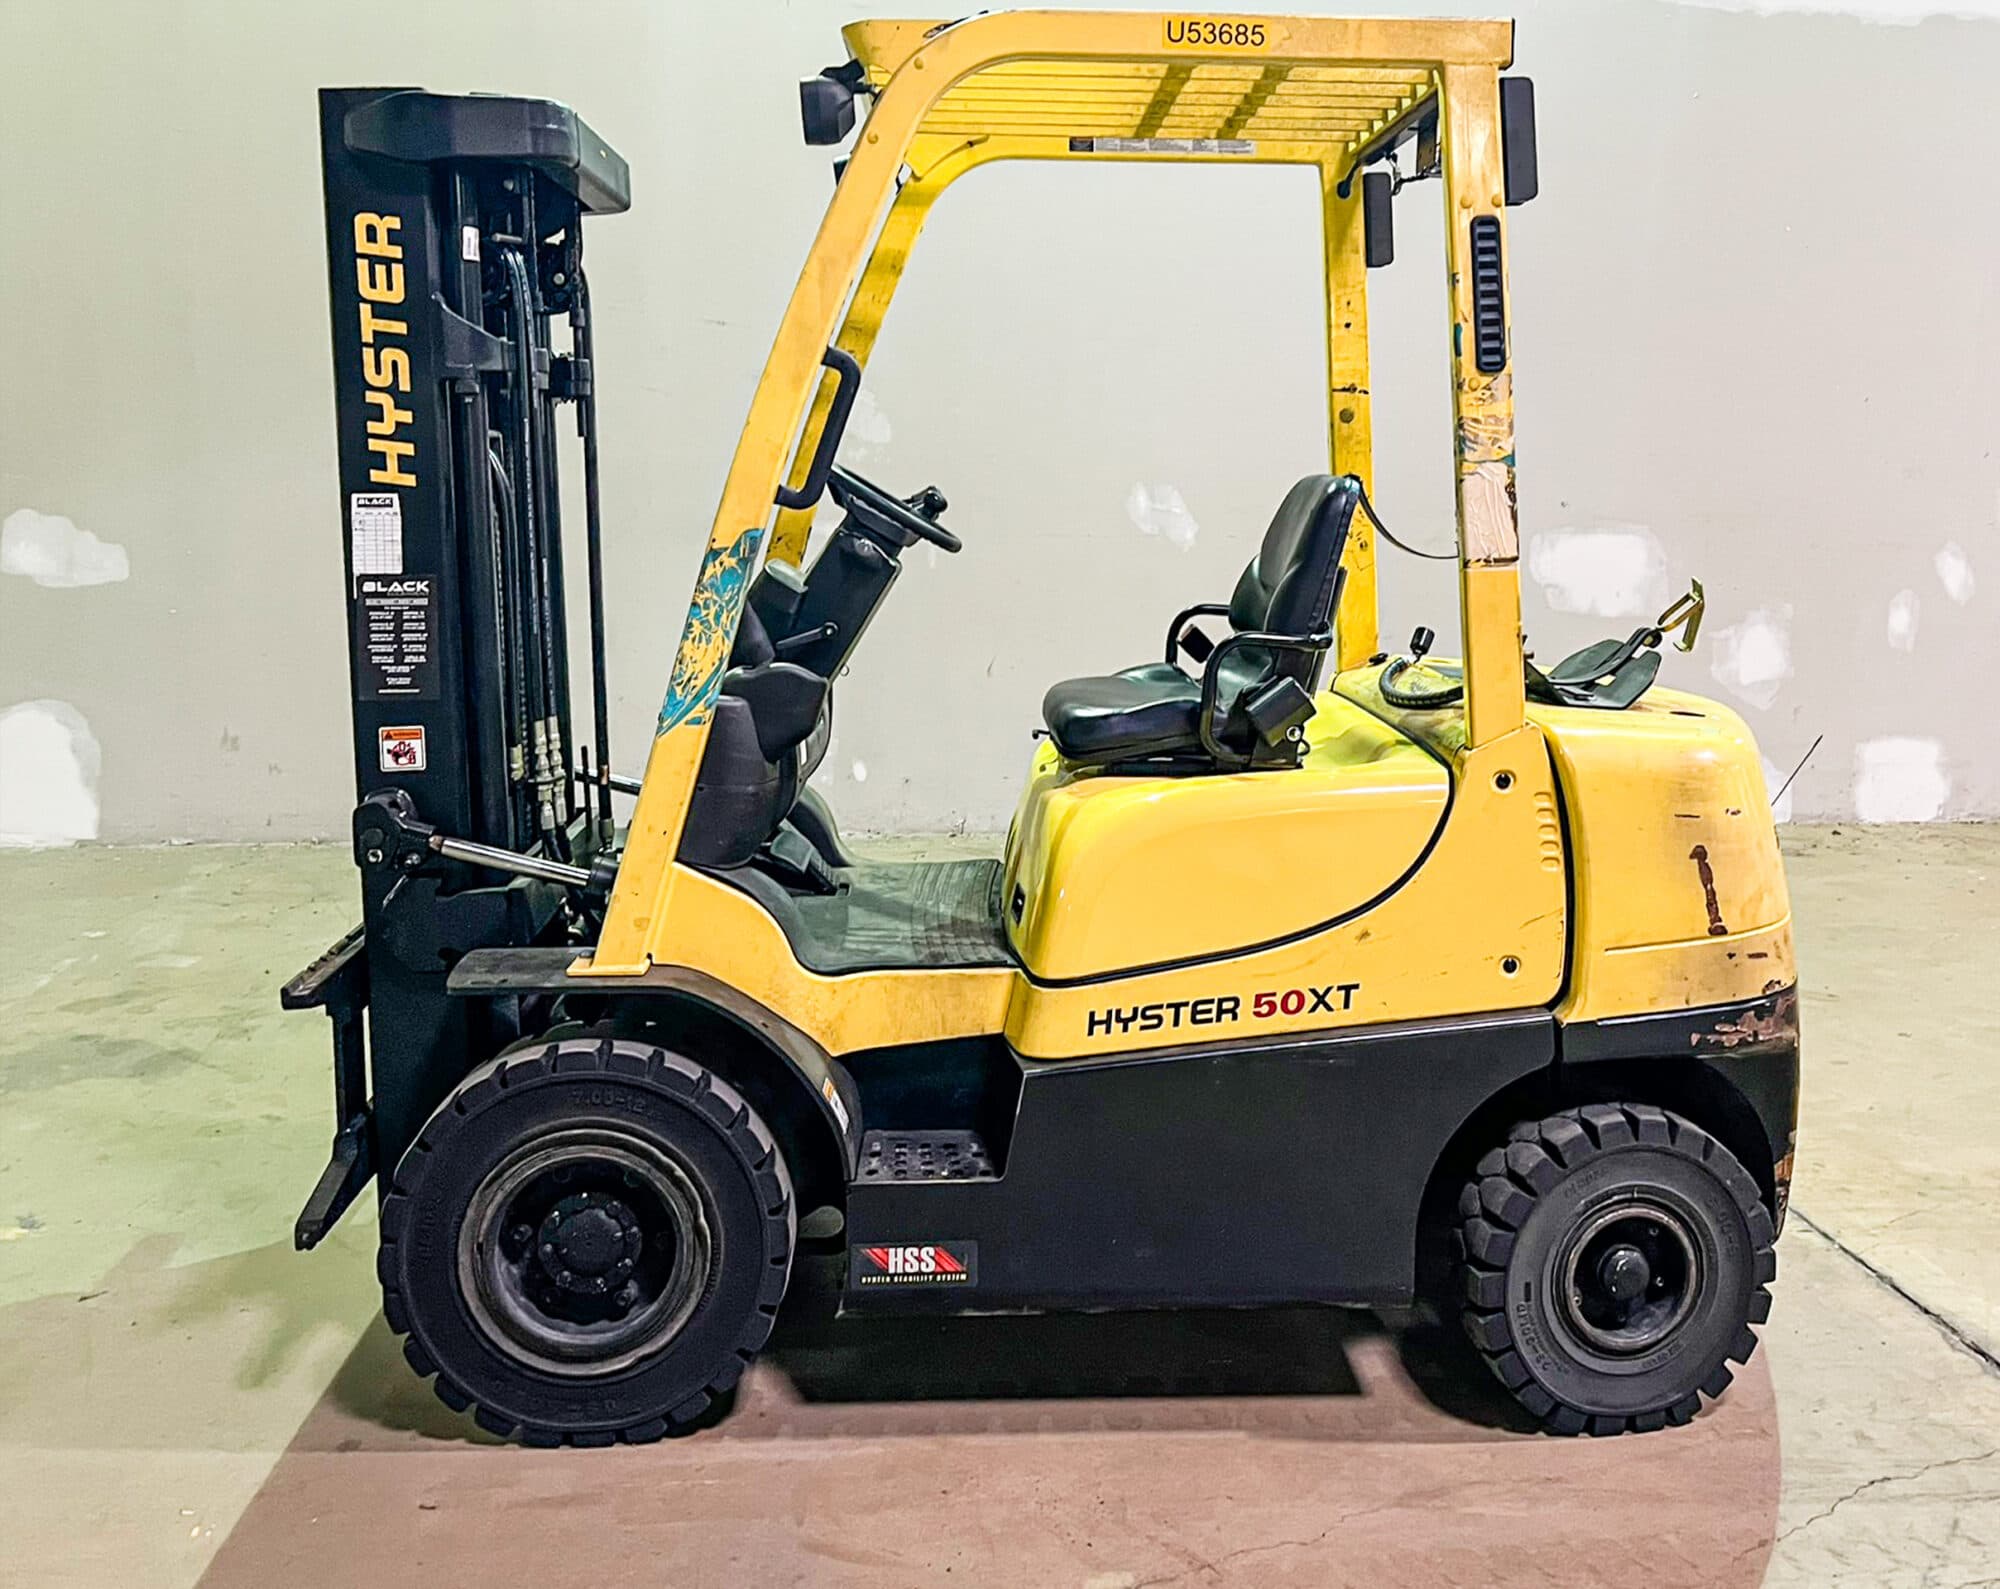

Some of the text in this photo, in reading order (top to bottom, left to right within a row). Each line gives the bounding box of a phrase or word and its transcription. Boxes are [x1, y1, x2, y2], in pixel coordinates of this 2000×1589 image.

[1167, 20, 1265, 46] U53685
[354, 211, 417, 487] HYSTER
[362, 581, 430, 593] BLACK
[1087, 983, 1360, 1036] HYSTER 50XT
[888, 1246, 936, 1274] HSS
